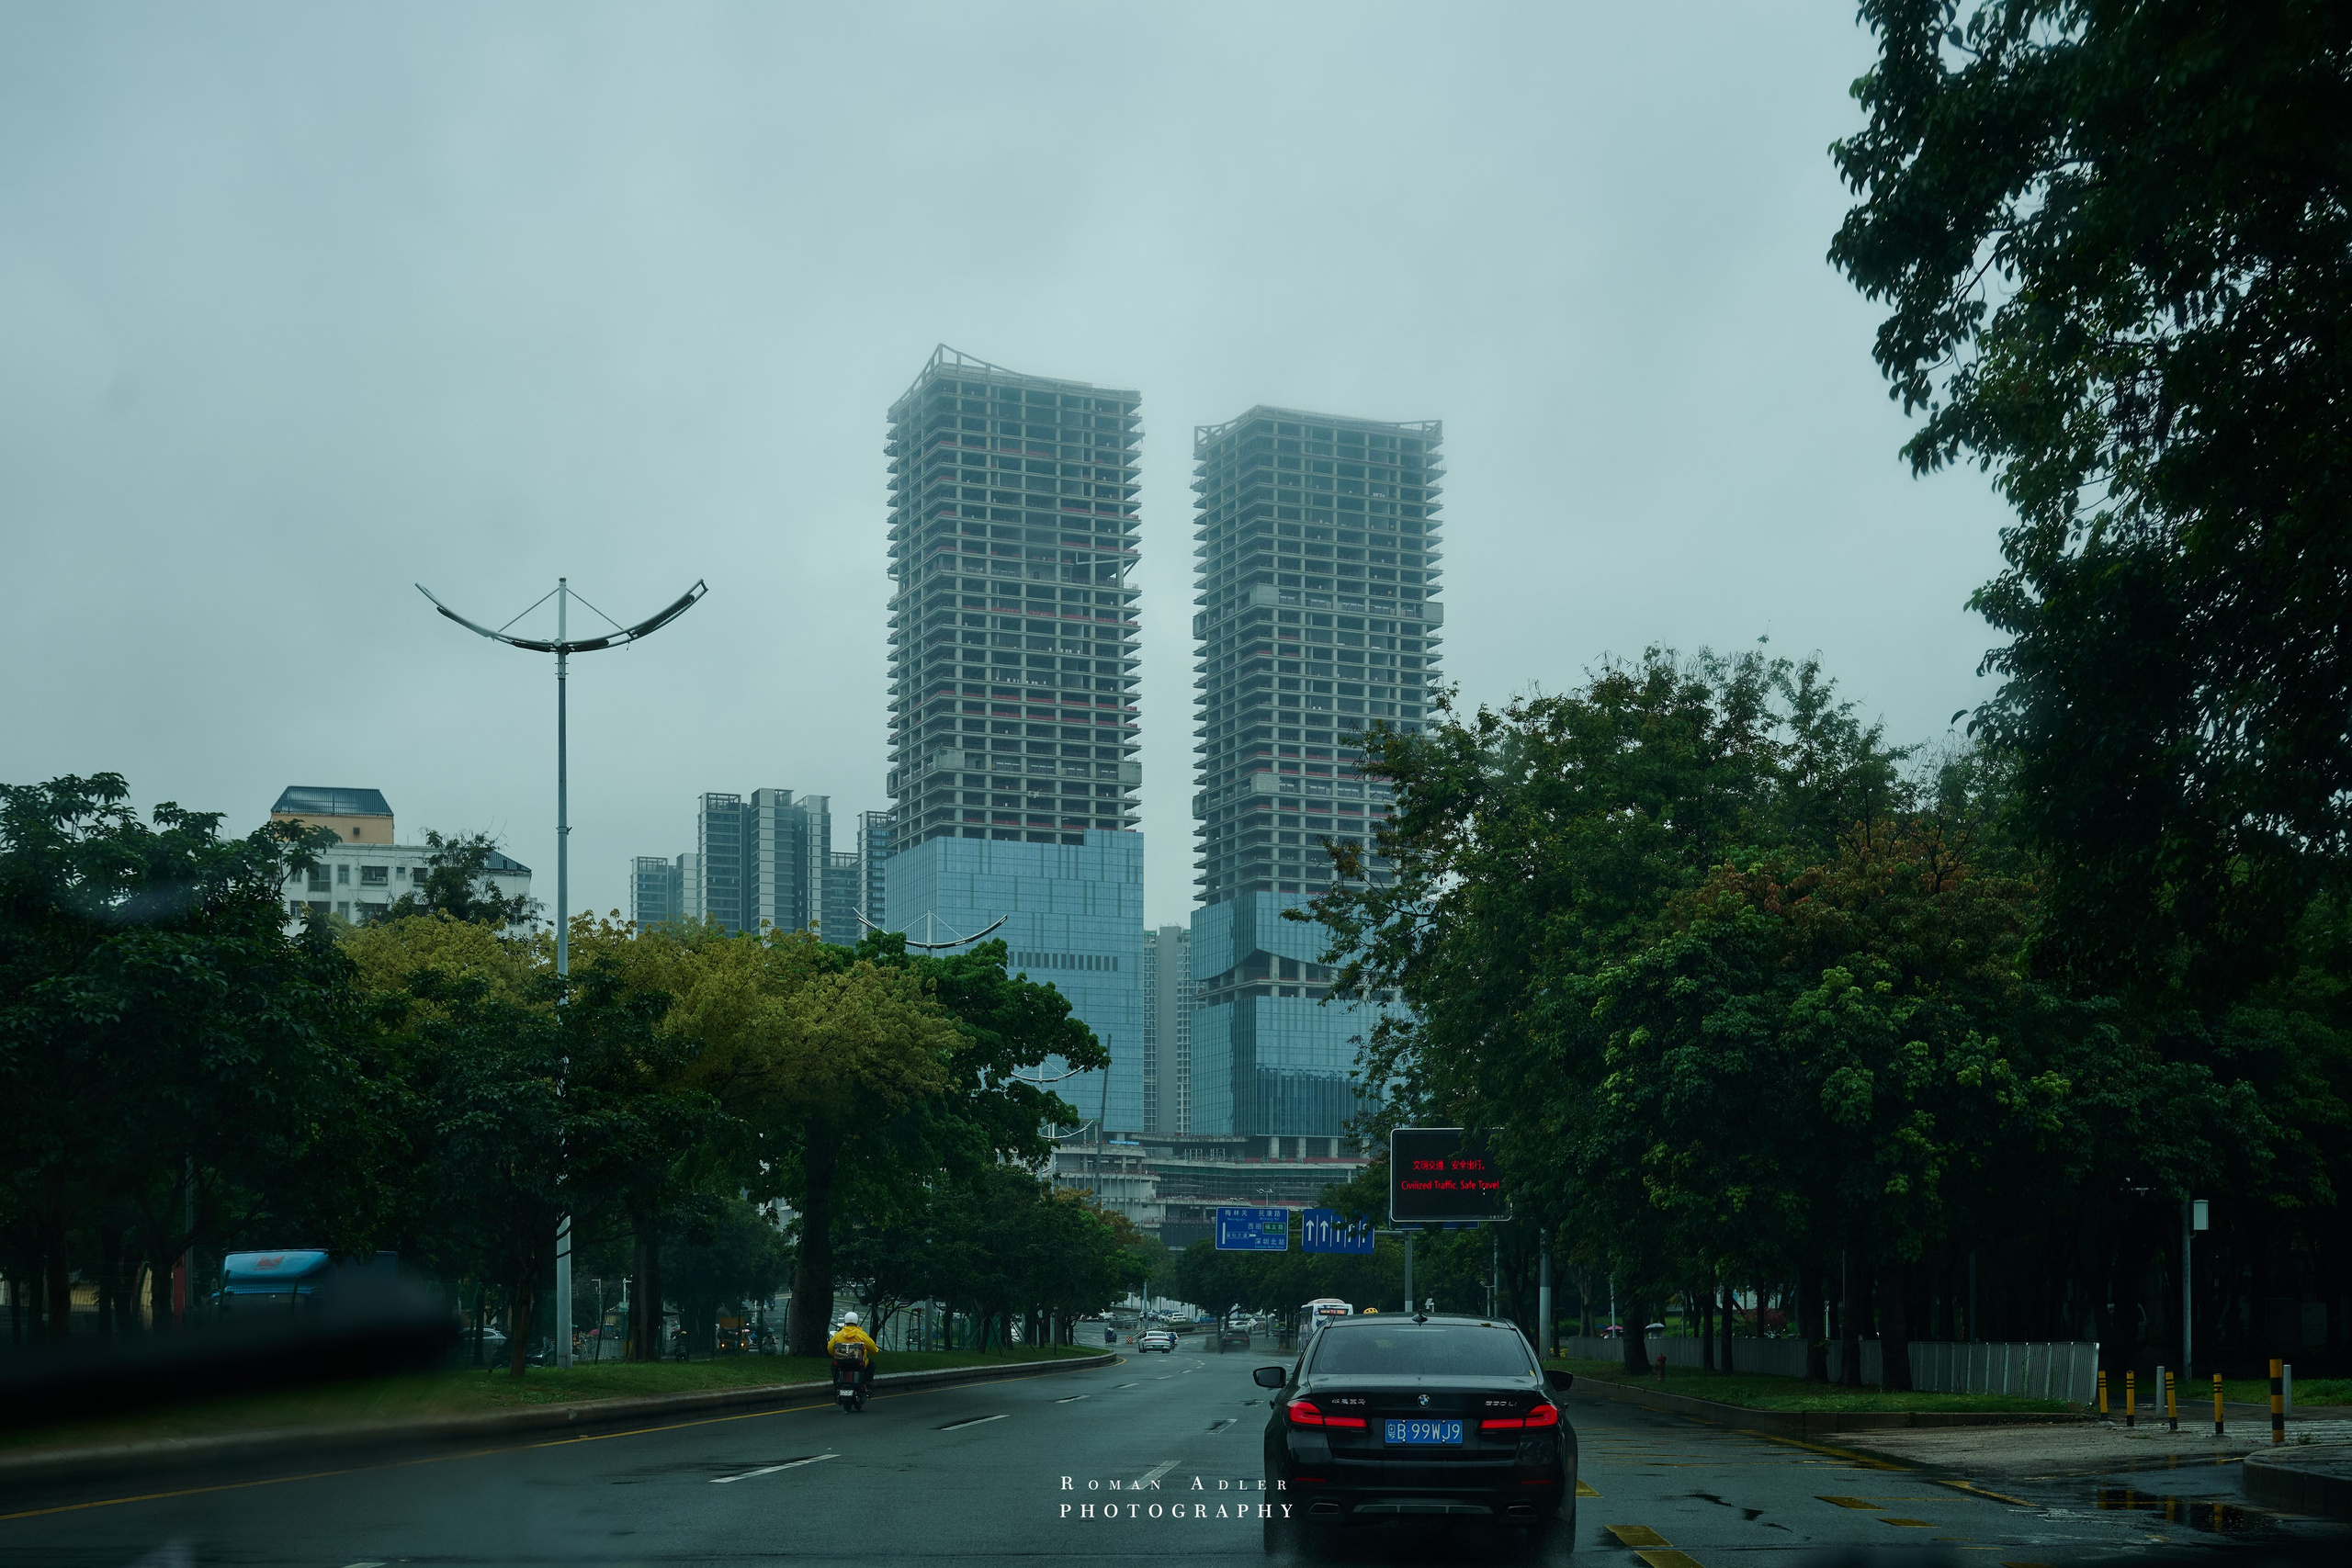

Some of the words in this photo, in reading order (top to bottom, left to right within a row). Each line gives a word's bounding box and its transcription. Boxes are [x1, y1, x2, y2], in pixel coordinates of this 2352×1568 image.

[1401, 1180, 1431, 1190] Civilized
[1460, 1180, 1476, 1190] Safe
[1478, 1180, 1499, 1190] Travel
